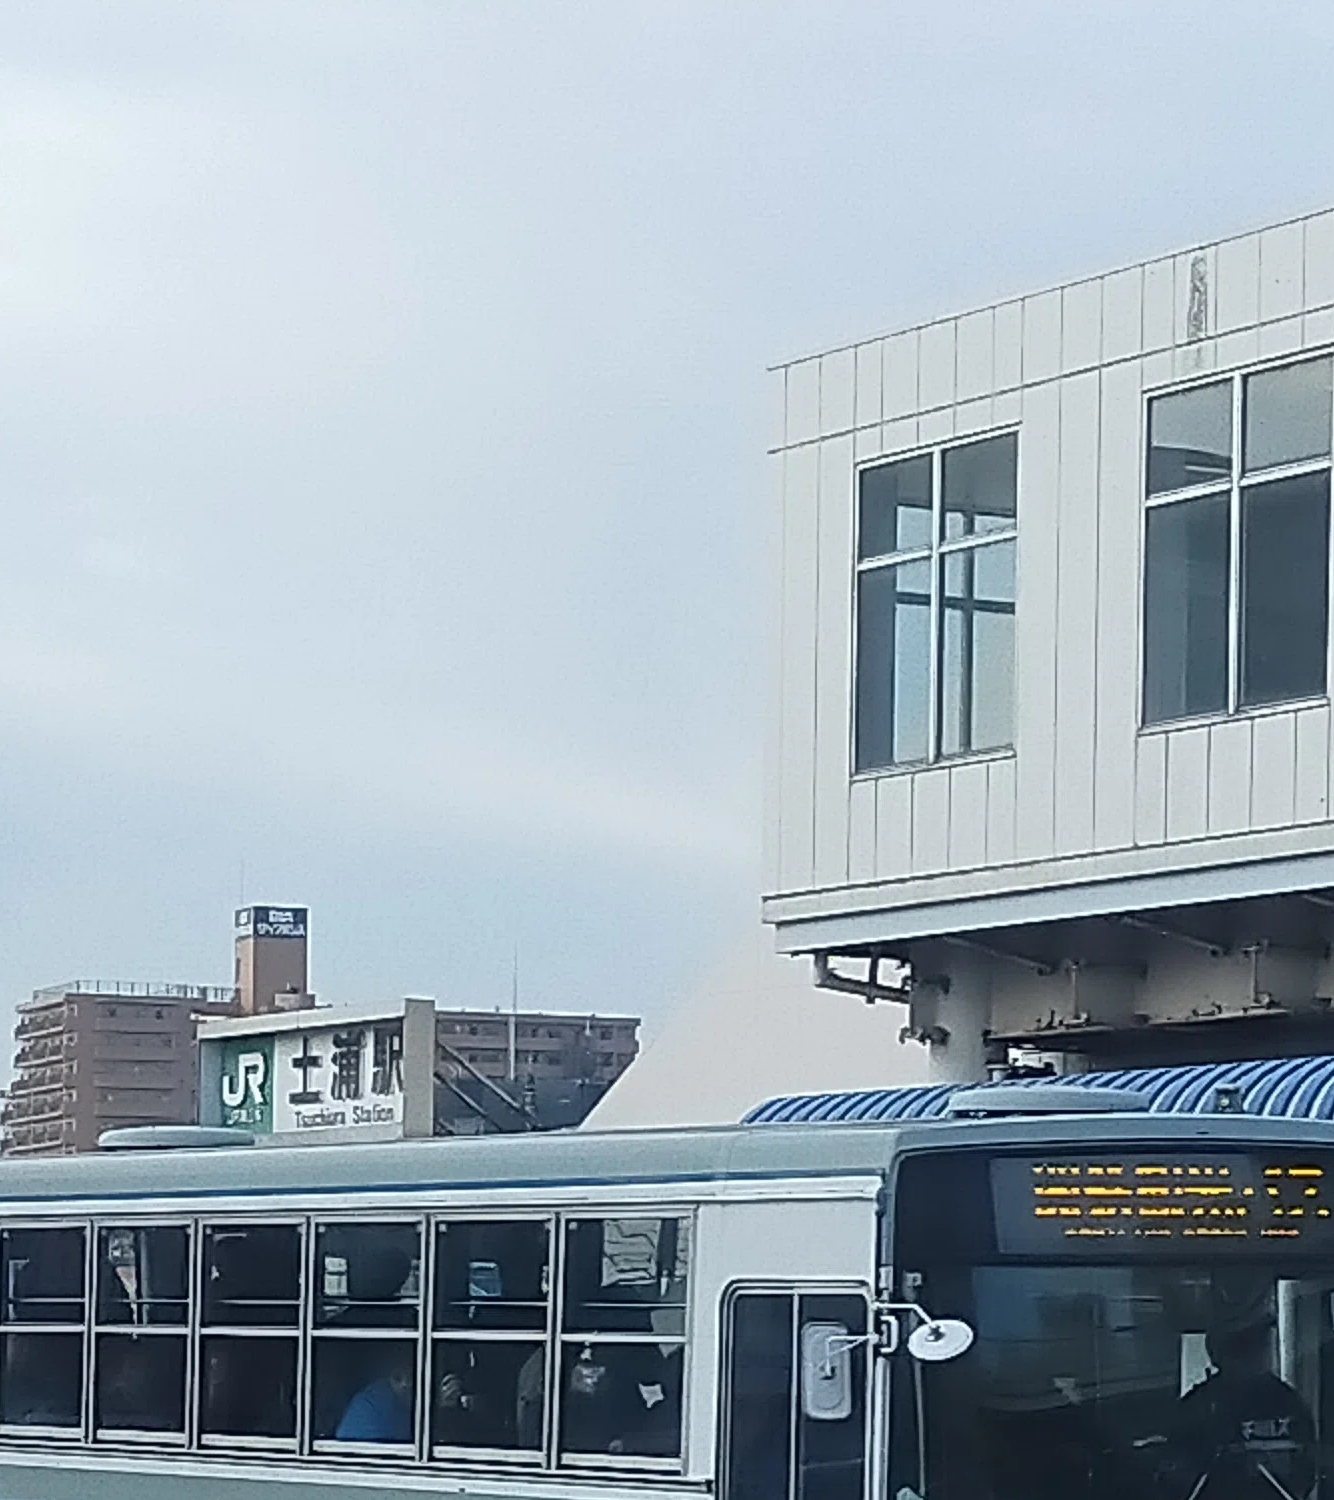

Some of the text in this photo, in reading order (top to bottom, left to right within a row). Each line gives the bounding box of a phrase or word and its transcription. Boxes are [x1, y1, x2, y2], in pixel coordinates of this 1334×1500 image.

[222, 1052, 264, 1107] JR
[288, 1030, 404, 1105] 土浦駅
[352, 1103, 394, 1124] Station
